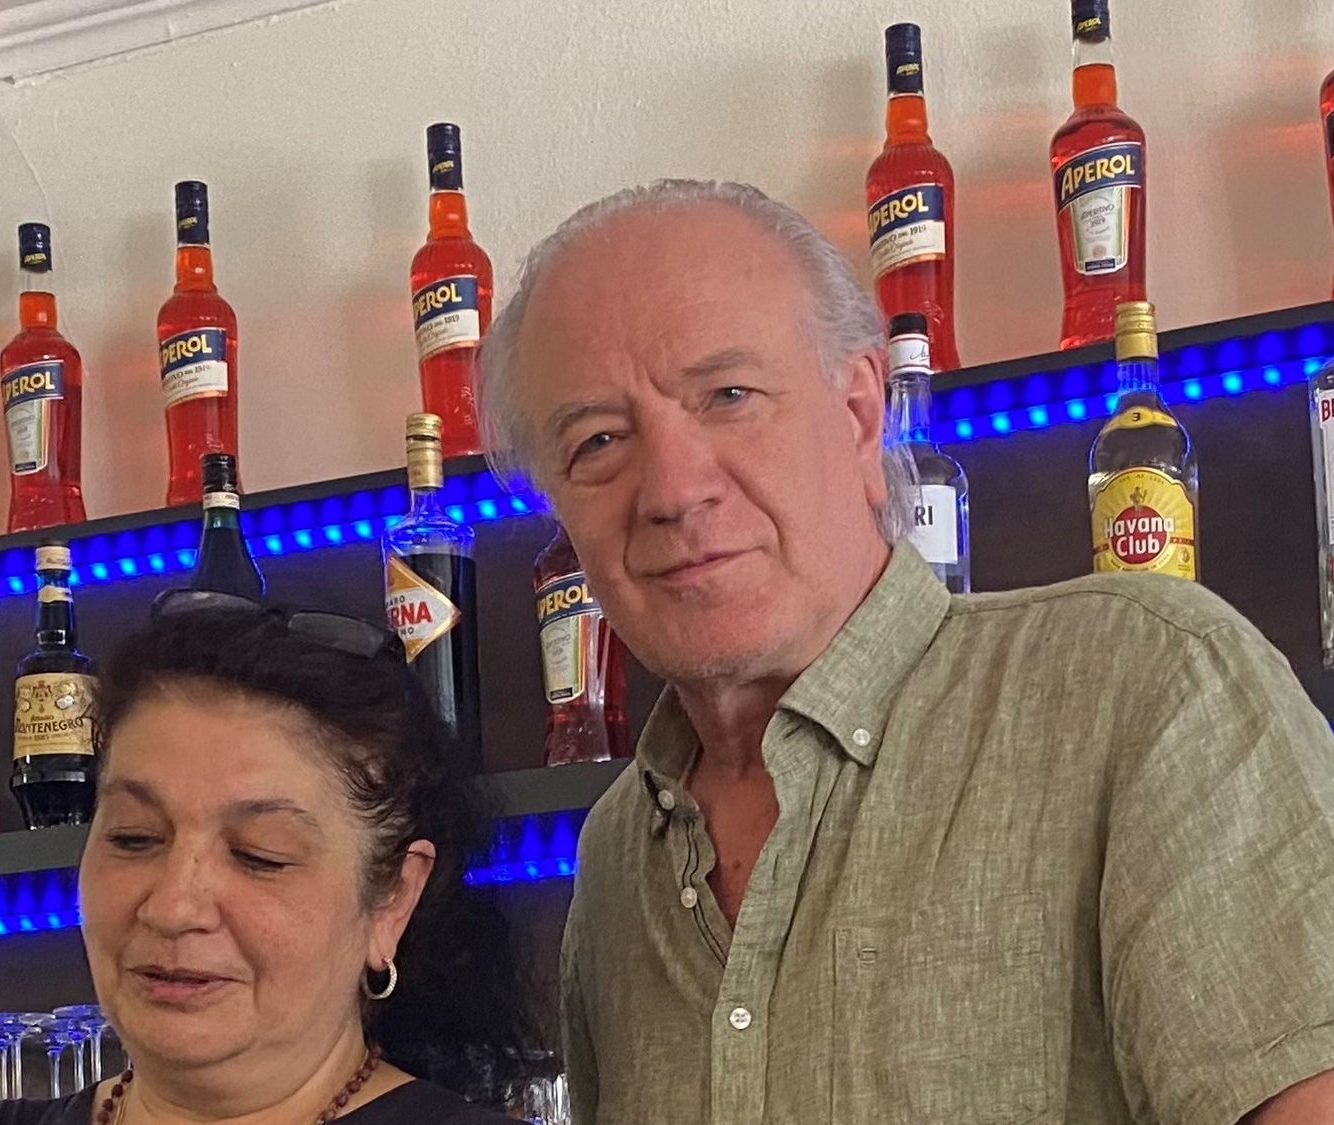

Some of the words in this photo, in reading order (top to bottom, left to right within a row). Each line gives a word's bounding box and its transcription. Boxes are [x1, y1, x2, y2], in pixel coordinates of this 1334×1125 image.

[1061, 154, 1135, 201] APEROL
[414, 283, 463, 318] PEROL
[161, 334, 213, 369] PEROL
[1132, 412, 1141, 422] 3
[914, 505, 934, 526] RI
[1104, 516, 1175, 539] Havana
[1116, 534, 1160, 557] Club
[388, 601, 433, 629] RNA
